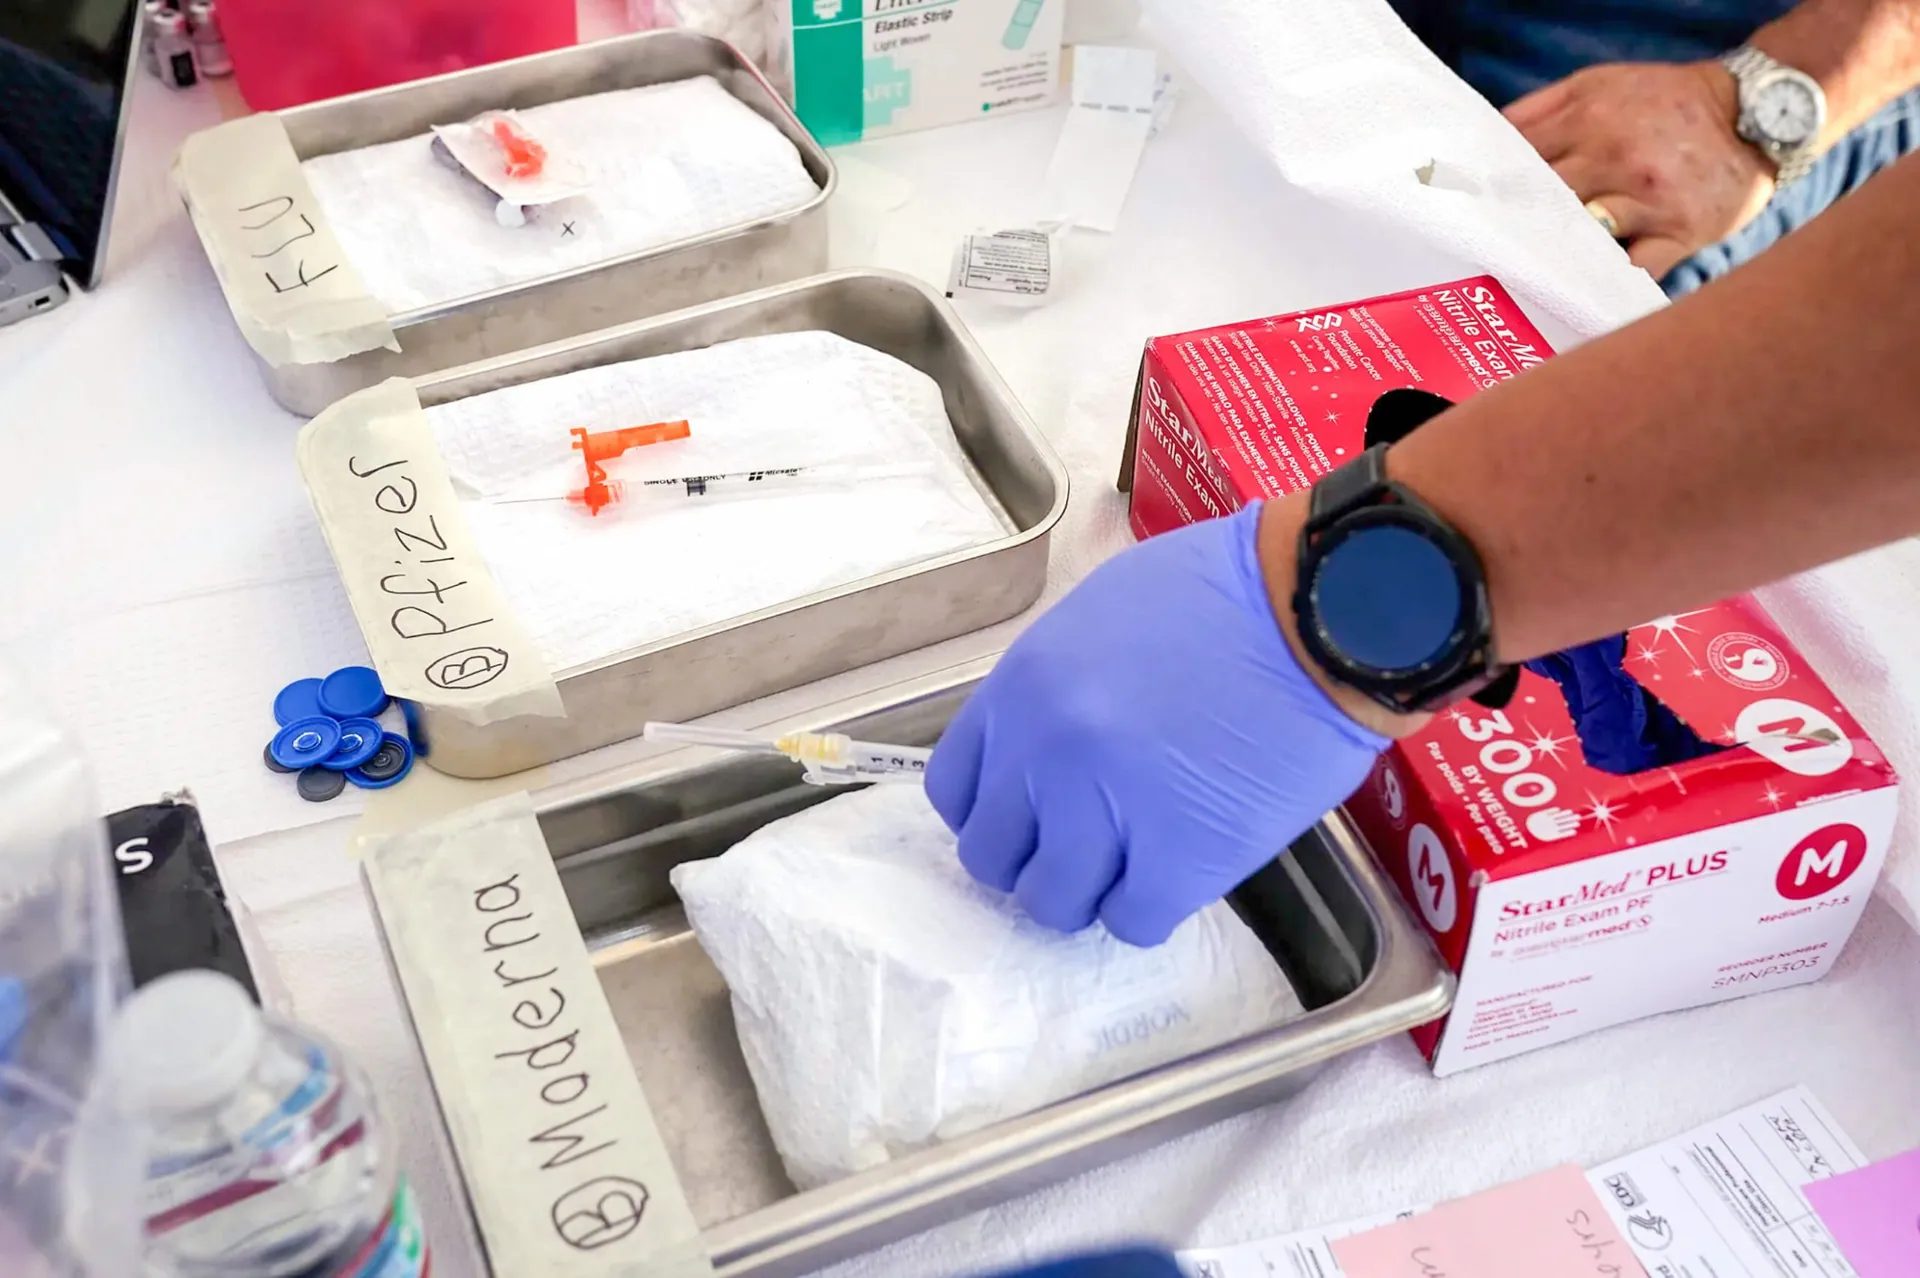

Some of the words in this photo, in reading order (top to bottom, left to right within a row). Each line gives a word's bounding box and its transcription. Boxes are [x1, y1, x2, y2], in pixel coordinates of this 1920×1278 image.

[874, 18, 918, 34] Elastic
[922, 8, 953, 25] Strip
[1418, 294, 1430, 303] by
[1433, 289, 1480, 337] Nitrile
[1360, 321, 1369, 330] us
[1364, 327, 1386, 349] proudly
[1367, 317, 1392, 344] purchase
[1388, 342, 1400, 351] of
[1462, 286, 1545, 370] StarM
[1325, 331, 1358, 370] Foundation
[1338, 329, 1364, 357] Prostate
[1360, 356, 1383, 381] Cancer
[1393, 347, 1406, 361] this
[1400, 359, 1424, 382] product
[1227, 332, 1244, 350] Single
[1239, 349, 1252, 361] Use
[1247, 361, 1262, 377] Only
[1261, 381, 1290, 419] Non-Sterile
[1236, 330, 1258, 352] NITRILE
[1253, 353, 1288, 397] EXAMINATION
[1282, 397, 1306, 427] GLOVES
[1183, 341, 1208, 371] GUANTES
[1202, 371, 1214, 381] DE
[1209, 381, 1231, 408] NITRILO
[1226, 409, 1244, 430] PARA
[1238, 430, 1268, 470] EXÁMENES
[1266, 476, 1280, 489] SIN
[1275, 488, 1286, 499] PO
[1209, 335, 1228, 356] GANTS
[1223, 356, 1250, 389] D'EXAMEN
[1245, 389, 1258, 399] EN
[1252, 400, 1276, 429] NITRILE
[1273, 435, 1291, 456] SANS
[1287, 457, 1311, 488] POUDRE
[1221, 369, 1230, 378] un
[1226, 379, 1242, 398] usage
[1239, 398, 1258, 423] unique
[1258, 429, 1271, 444] Non
[1287, 476, 1301, 493] Amb
[1194, 376, 1206, 387] una
[1201, 387, 1212, 398] vez
[1211, 402, 1222, 413] No
[1217, 413, 1228, 424] son
[1251, 468, 1274, 500] Ambidext
[1146, 409, 1183, 470] Nitrile
[1186, 463, 1220, 520] Exam
[348, 455, 494, 639] Pfizer
[891, 756, 904, 767] 2
[912, 759, 925, 769] 3
[1458, 709, 1557, 807] 300
[1426, 741, 1445, 761] Par
[1436, 762, 1466, 795] poids
[1464, 803, 1485, 825] Por
[1476, 825, 1505, 855] peso
[1460, 764, 1486, 785] BY
[1476, 786, 1529, 848] WEIGHT
[114, 837, 154, 875] S
[1417, 843, 1446, 912] M
[1647, 850, 1729, 886] PLUS
[1794, 839, 1848, 887] M
[1494, 917, 1558, 945] Nitrile
[1564, 905, 1620, 929] Exam
[1757, 905, 1813, 925] Medium
[1711, 955, 1821, 990] SMNP303
[1717, 954, 1775, 973] REORDER
[1777, 941, 1829, 959] NUMBER
[474, 873, 618, 1170] Moderna
[1609, 1177, 1636, 1207] CDC
